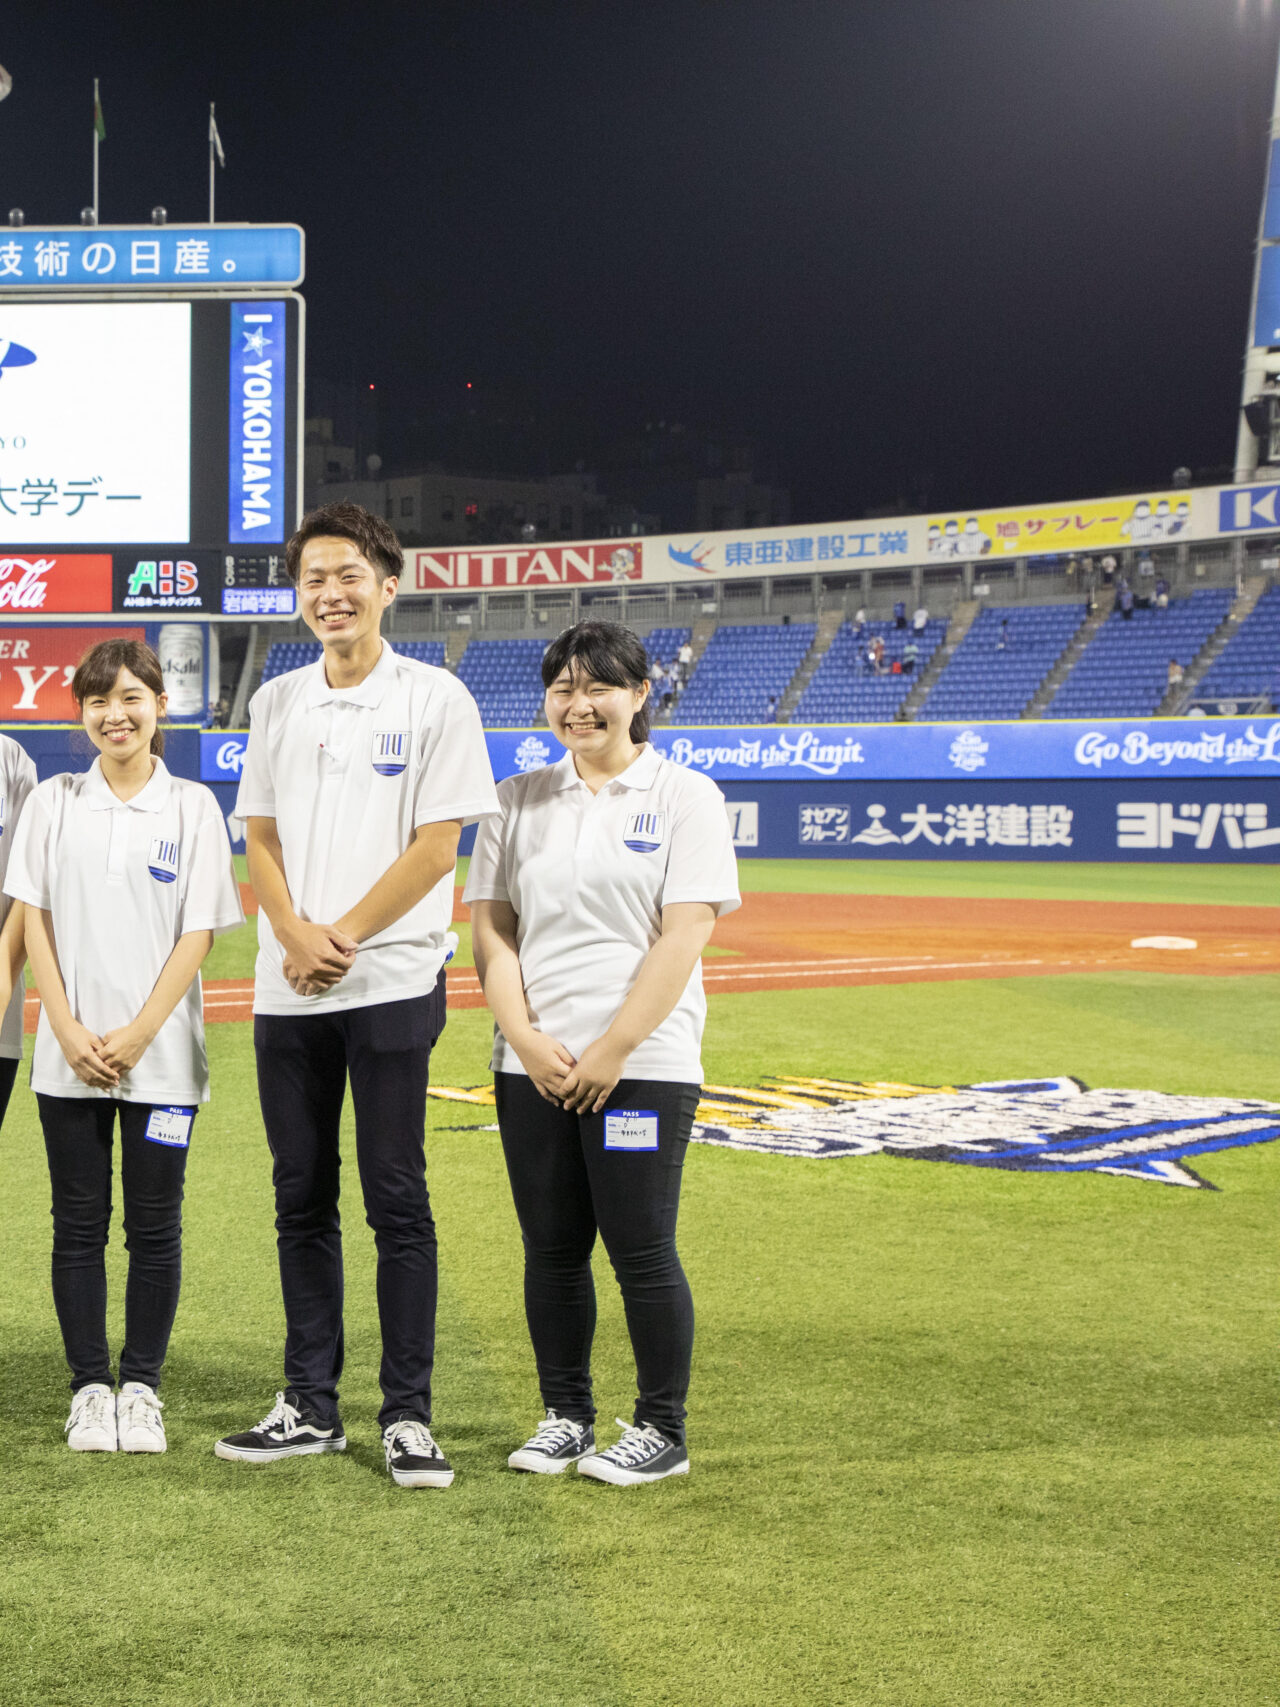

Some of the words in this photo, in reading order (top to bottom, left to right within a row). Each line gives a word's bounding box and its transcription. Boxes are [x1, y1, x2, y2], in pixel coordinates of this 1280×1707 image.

[242, 358, 273, 531] YOKOHAMA
[418, 547, 595, 587] NITTAN
[724, 529, 909, 567] 東亜建設工業
[670, 738, 762, 770] Beyond
[761, 746, 790, 769] the
[1074, 731, 1120, 768] Go
[1120, 731, 1226, 766] Beyond
[1225, 738, 1260, 765] the
[801, 807, 849, 825] オセアン
[900, 803, 1074, 847] 大洋建設
[1116, 802, 1280, 849] ヨドバシ
